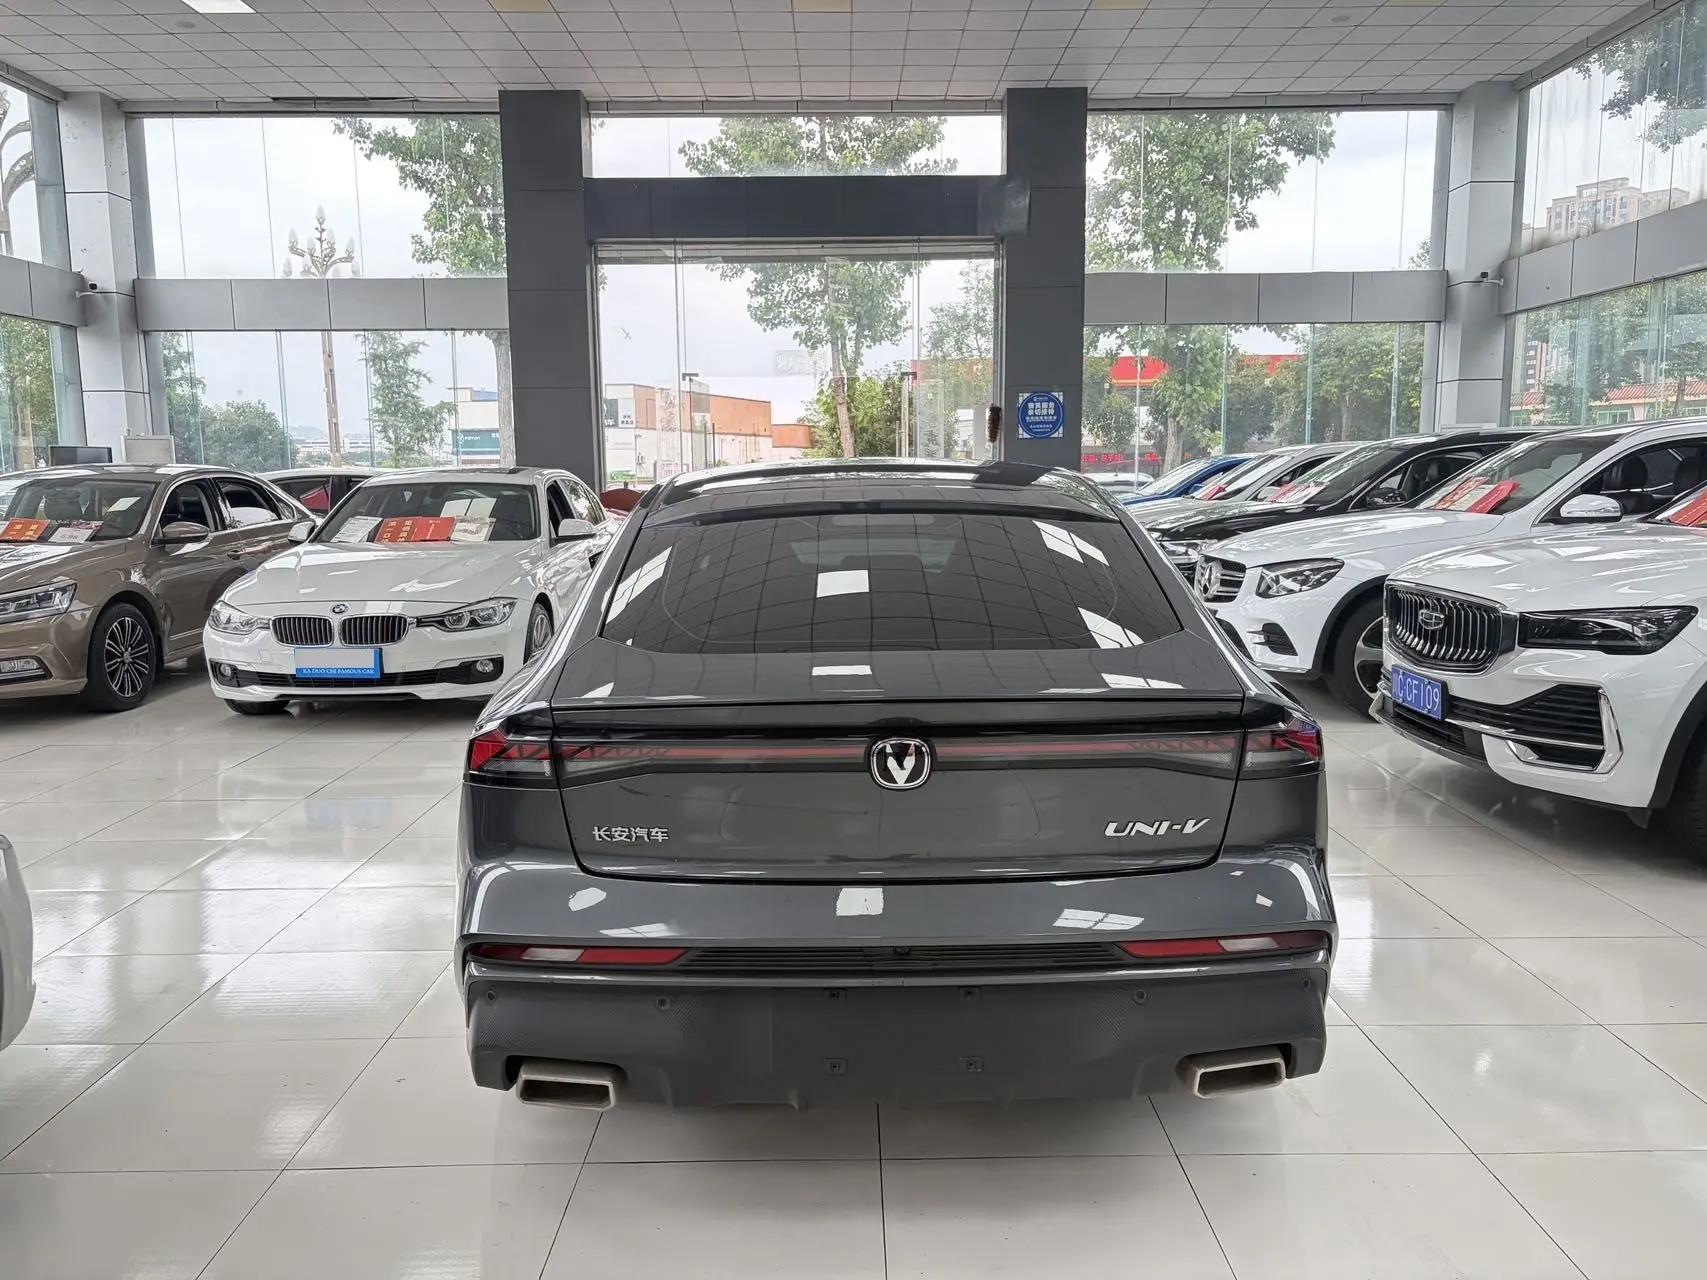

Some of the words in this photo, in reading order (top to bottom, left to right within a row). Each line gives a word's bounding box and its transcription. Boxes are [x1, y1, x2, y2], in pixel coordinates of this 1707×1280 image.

[592, 826, 669, 843] 长安汽车
[1104, 818, 1211, 837] UNI-V
